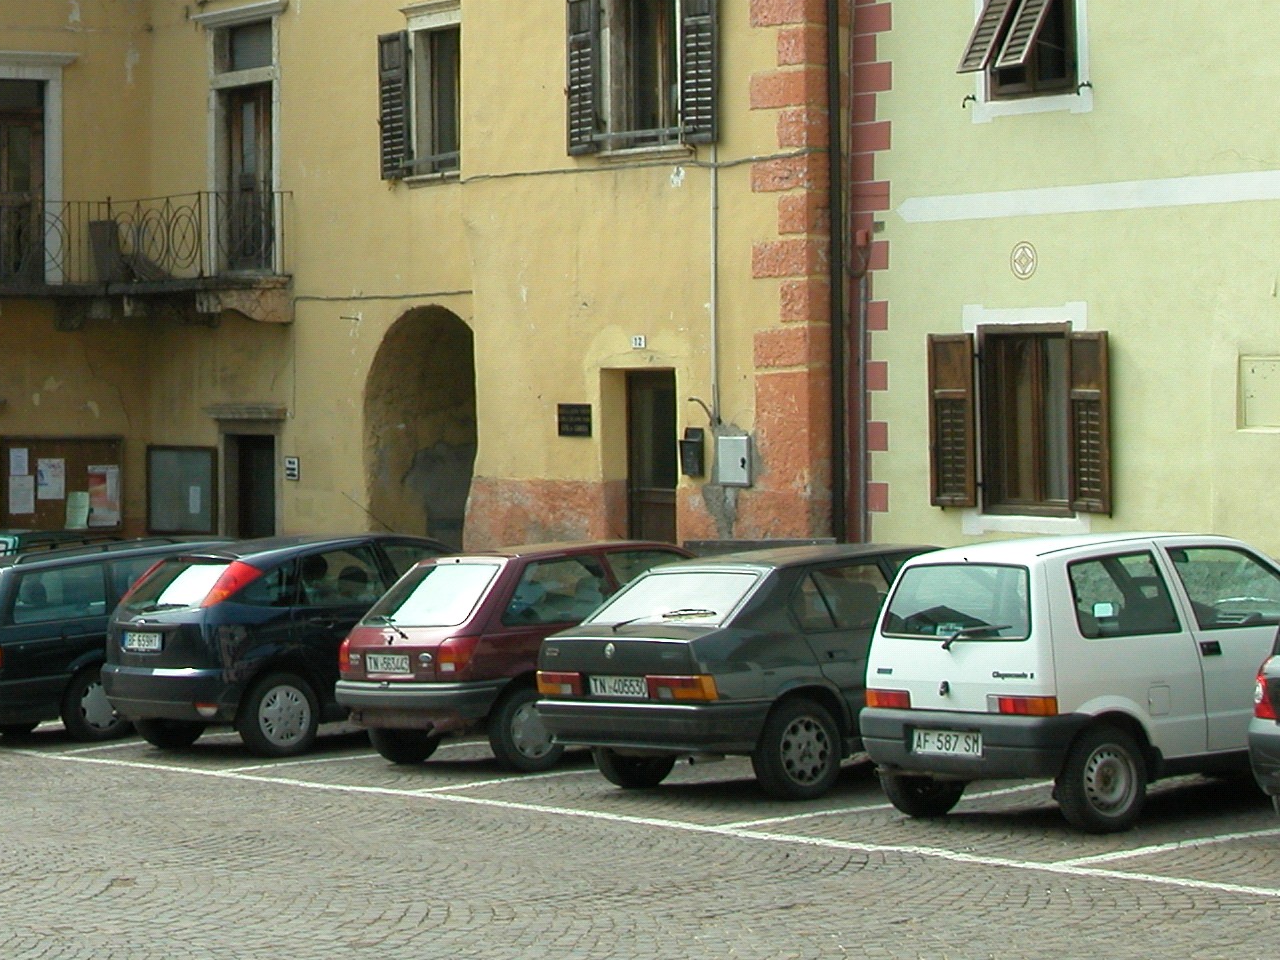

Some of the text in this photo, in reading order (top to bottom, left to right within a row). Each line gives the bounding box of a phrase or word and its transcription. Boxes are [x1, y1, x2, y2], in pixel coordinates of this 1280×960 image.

[634, 337, 642, 346] 12
[368, 656, 379, 670] TN
[592, 678, 606, 694] TN
[916, 732, 931, 750] AF
[936, 732, 959, 752] 587
